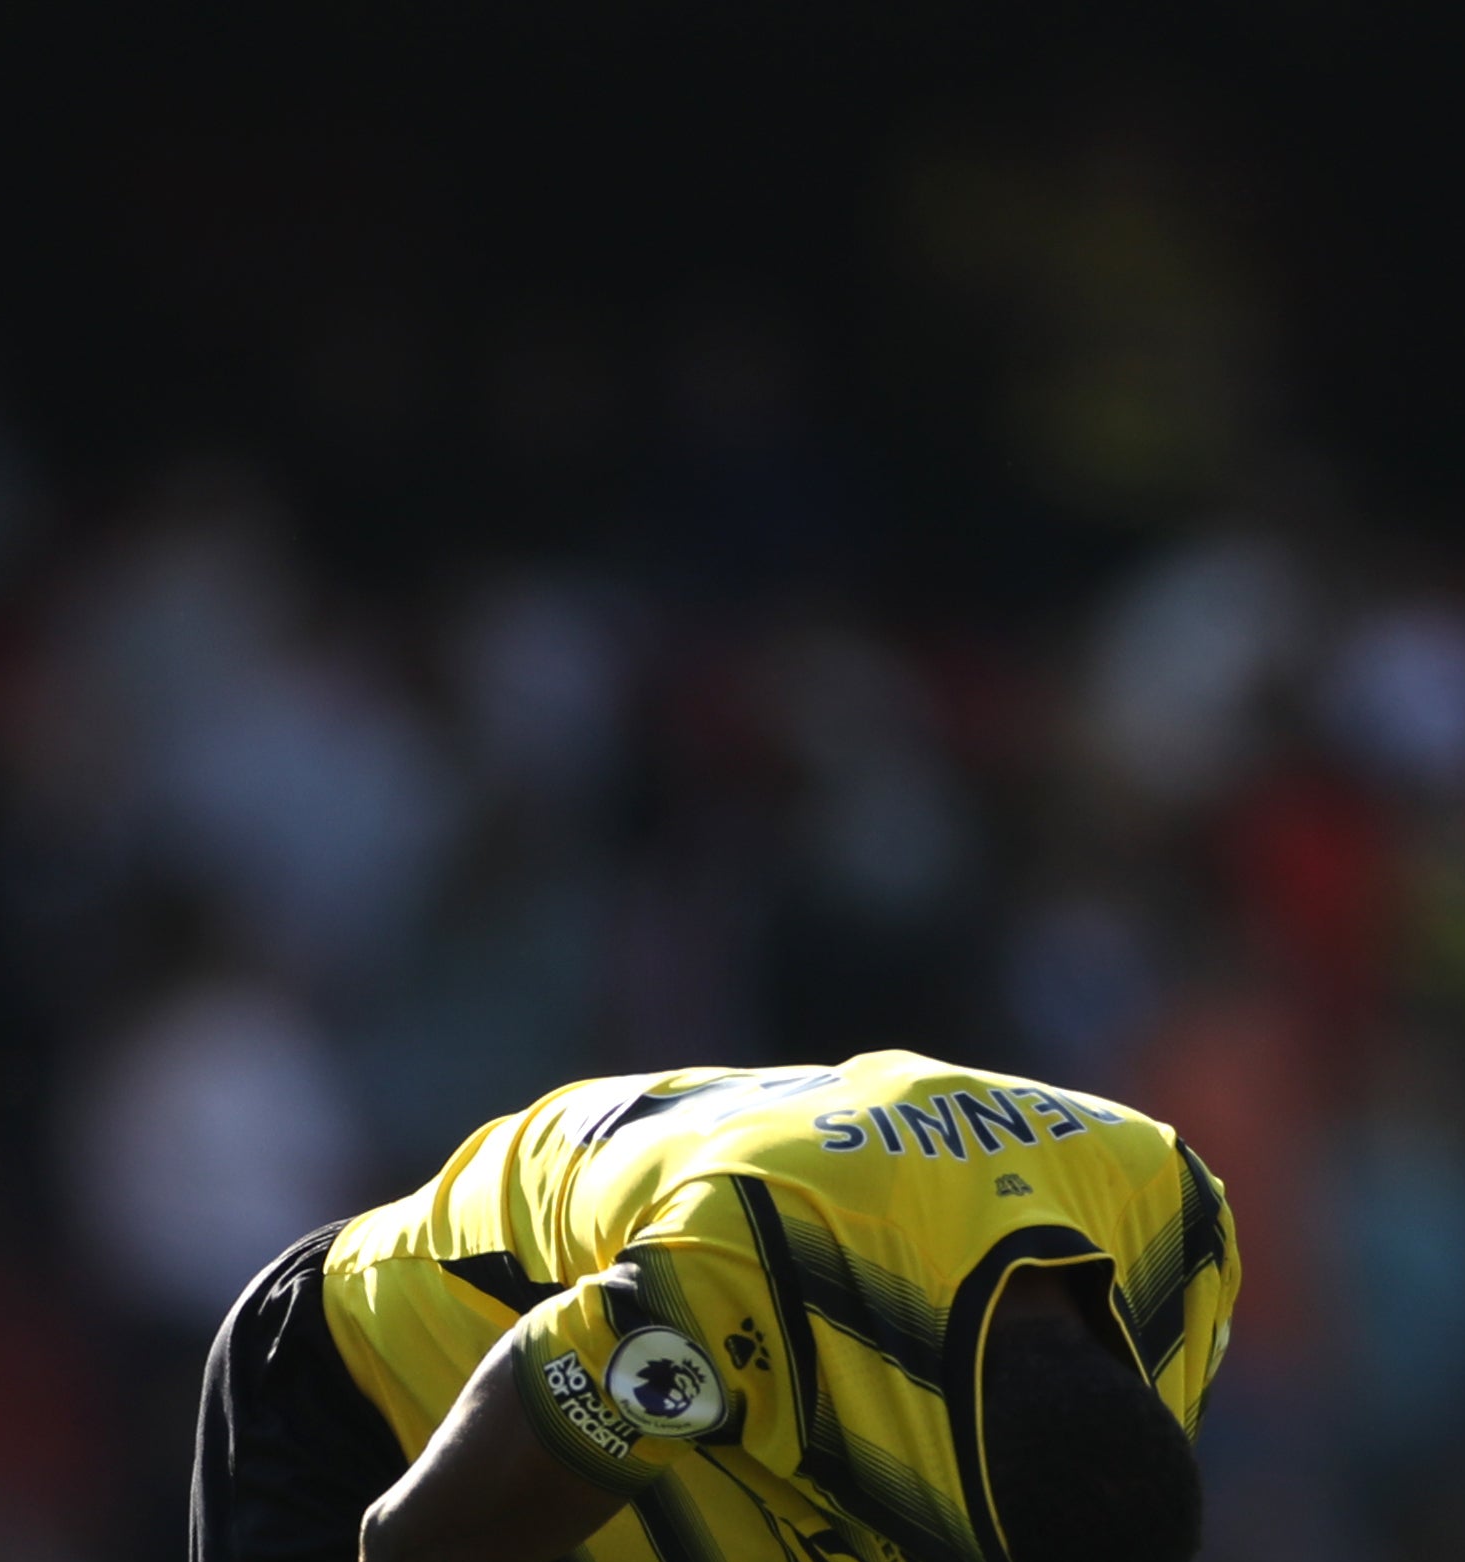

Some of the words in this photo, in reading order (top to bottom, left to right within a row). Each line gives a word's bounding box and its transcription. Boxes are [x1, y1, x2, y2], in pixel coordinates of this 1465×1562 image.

[544, 1360, 570, 1396] For
[561, 1398, 629, 1459] racism
[561, 1351, 587, 1392] No
[578, 1392, 636, 1438] room
